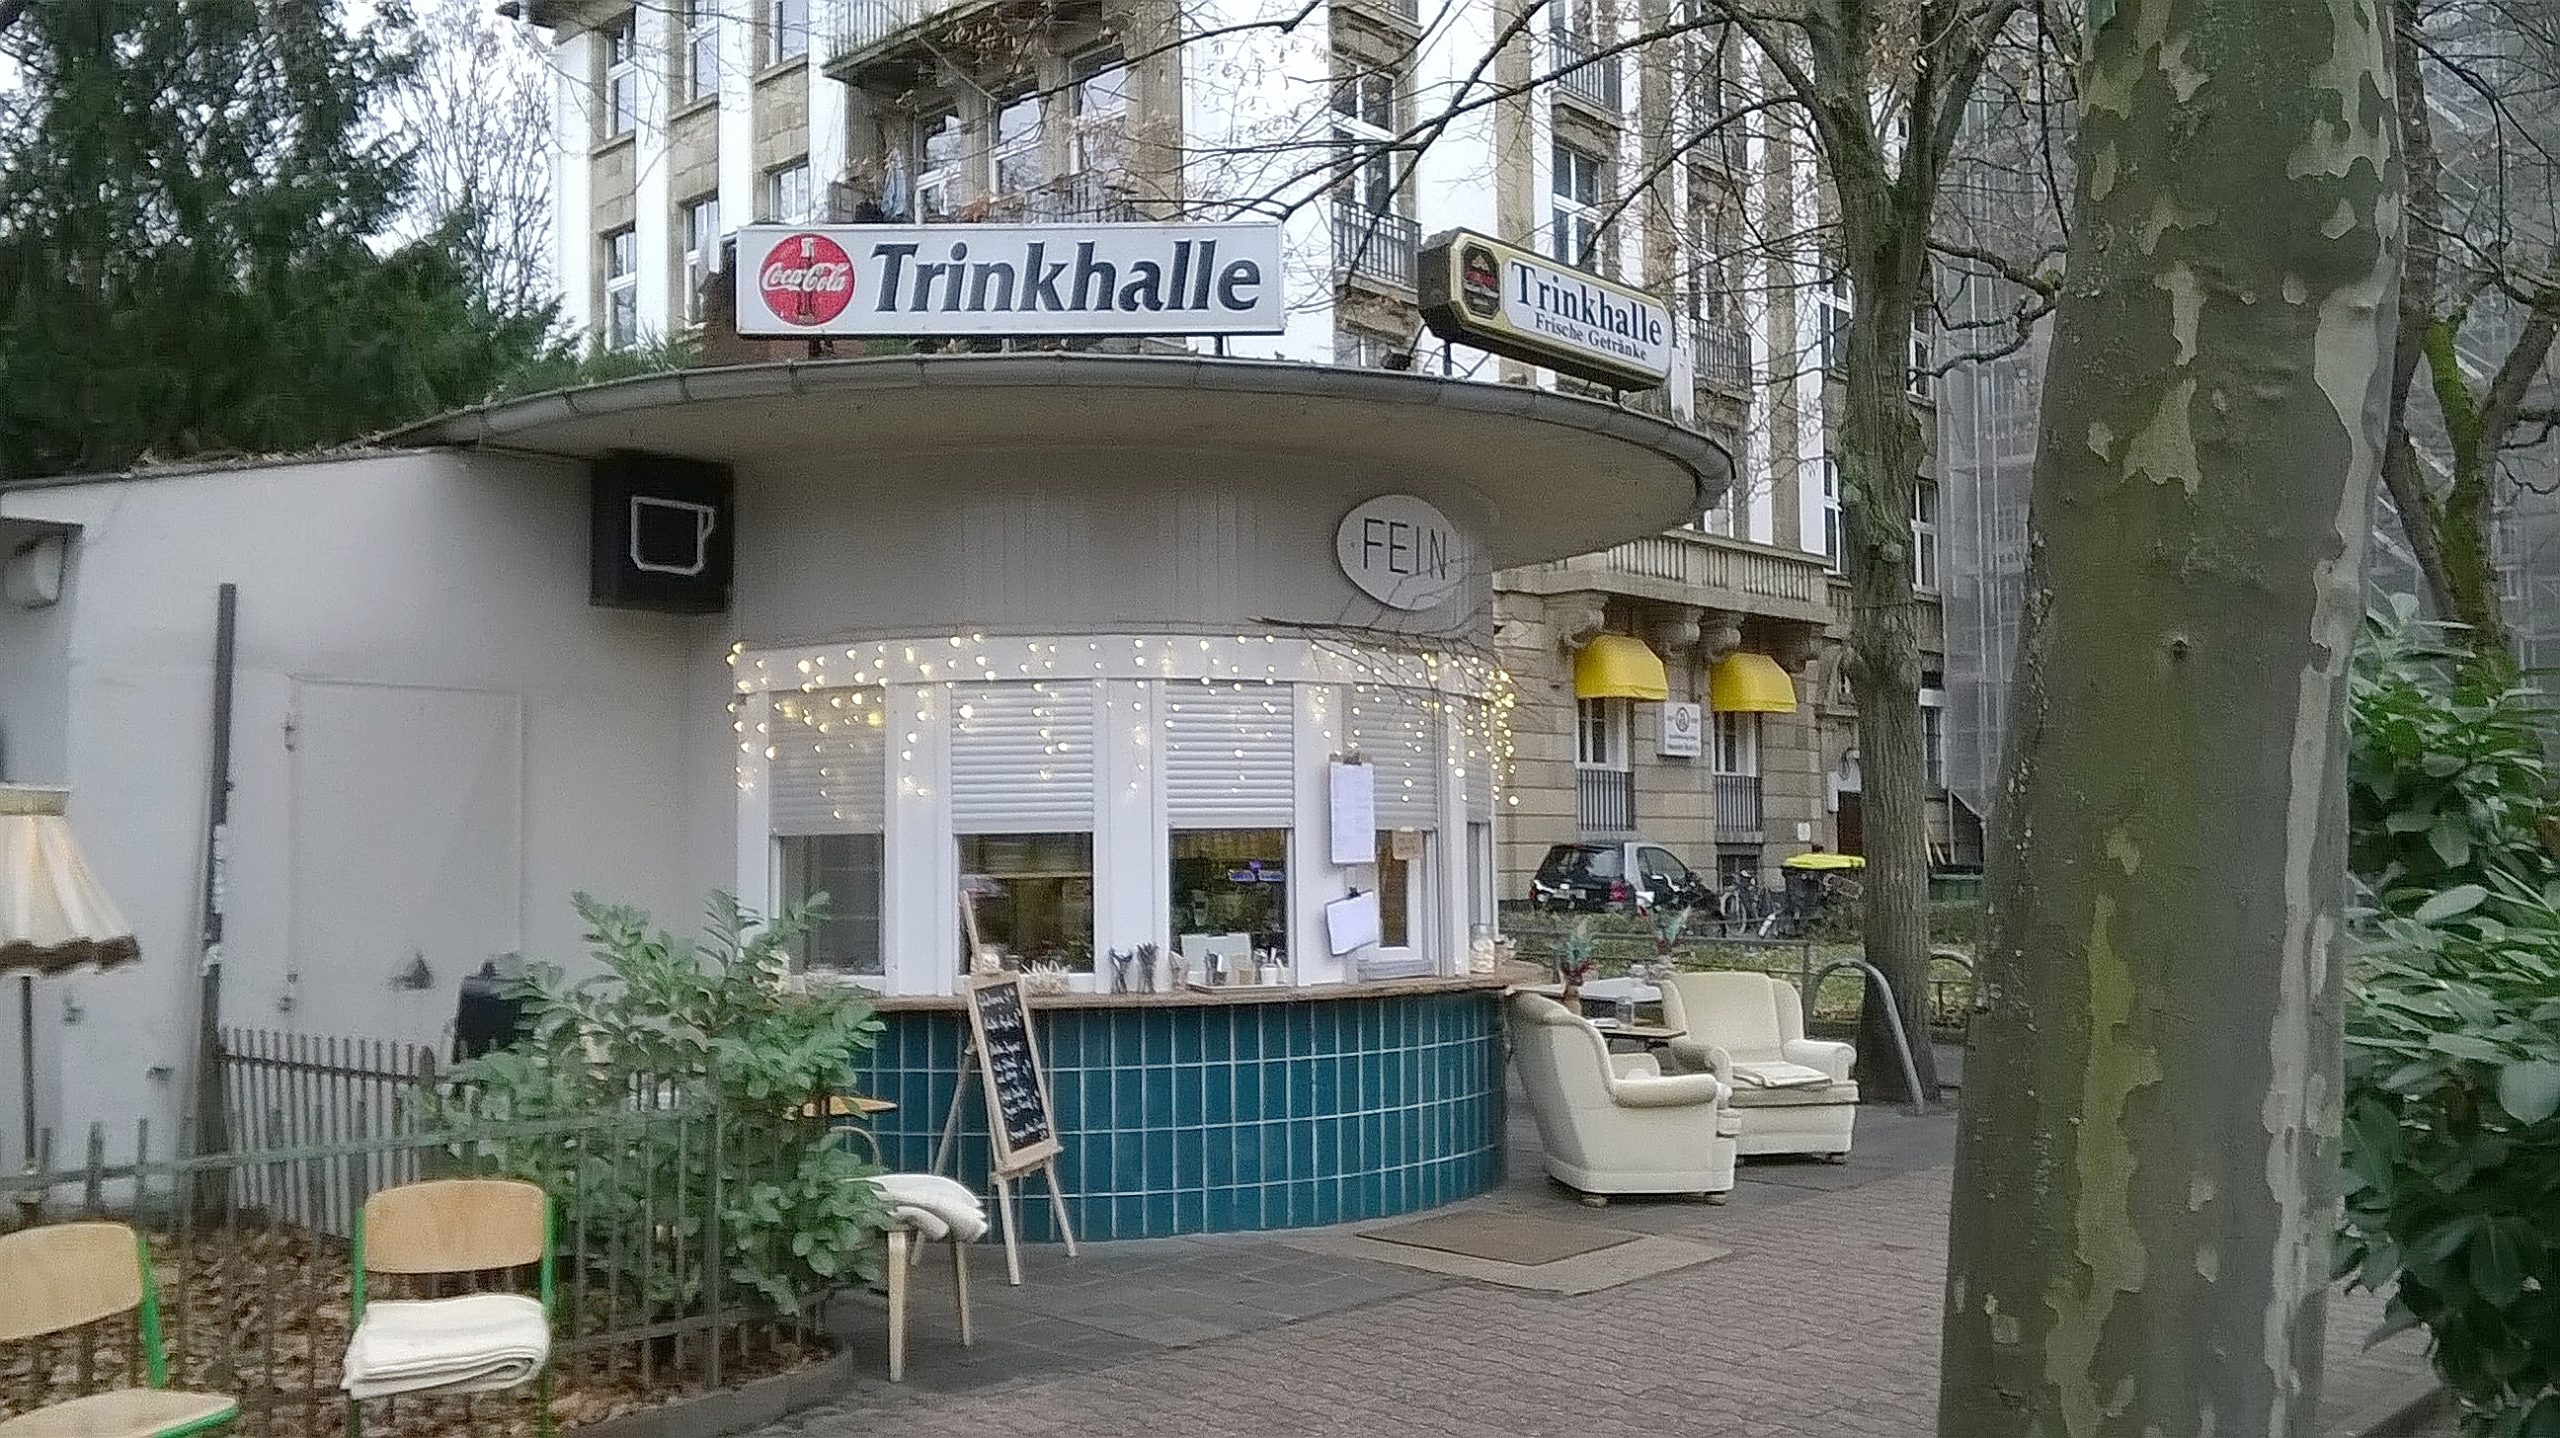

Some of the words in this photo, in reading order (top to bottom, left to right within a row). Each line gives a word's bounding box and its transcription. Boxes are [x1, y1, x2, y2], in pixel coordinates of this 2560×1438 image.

[871, 240, 1262, 313] Trinkhalle
[1511, 261, 1663, 347] Trinkhalle
[1535, 312, 1584, 342] Frische
[1587, 329, 1649, 362] Getränke
[1363, 517, 1447, 580] FEIN
